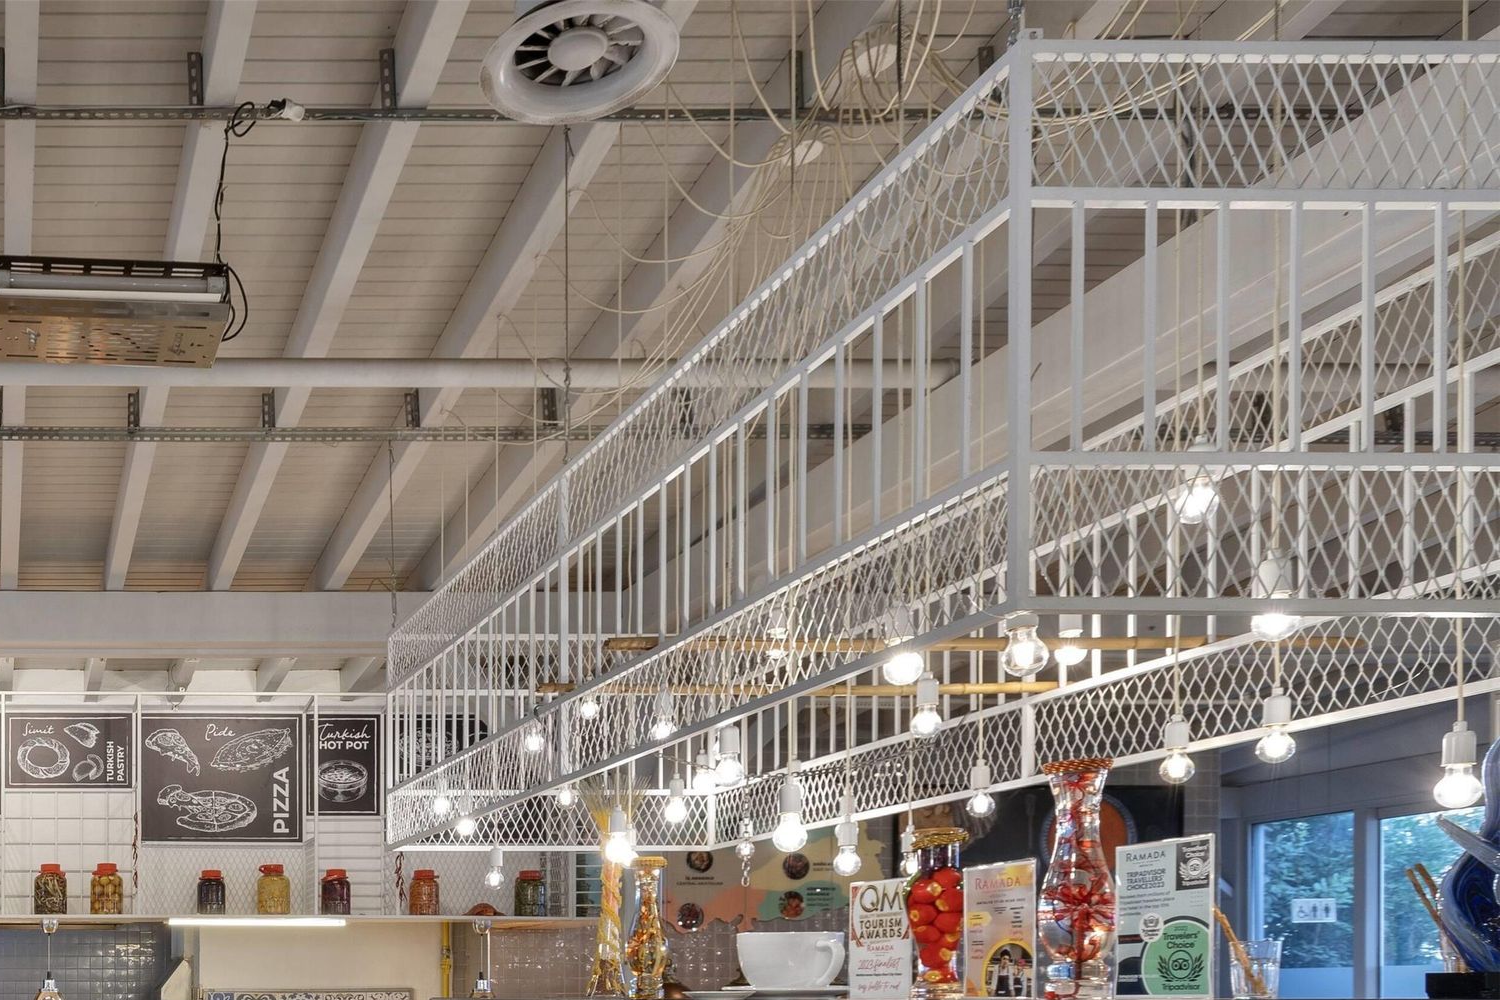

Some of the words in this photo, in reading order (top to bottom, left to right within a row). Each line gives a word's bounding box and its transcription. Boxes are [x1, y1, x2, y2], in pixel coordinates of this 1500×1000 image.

[22, 722, 55, 736] Simit
[205, 723, 236, 741] Pide
[318, 723, 371, 741] Turkish
[319, 740, 342, 750] HOT
[346, 740, 370, 750] POT
[106, 741, 115, 782] TURKISH
[116, 745, 125, 782] PASTRY
[273, 766, 290, 833] PIZZA
[1126, 850, 1166, 862] RAMADA
[975, 876, 1021, 890] RAMADA
[860, 883, 904, 913] QM
[860, 918, 902, 930] TOURISM
[860, 928, 903, 939] AWARDS
[867, 944, 894, 952] RAMADA
[1166, 940, 1195, 949] Choice
[1162, 983, 1200, 991] Tripadvisor
